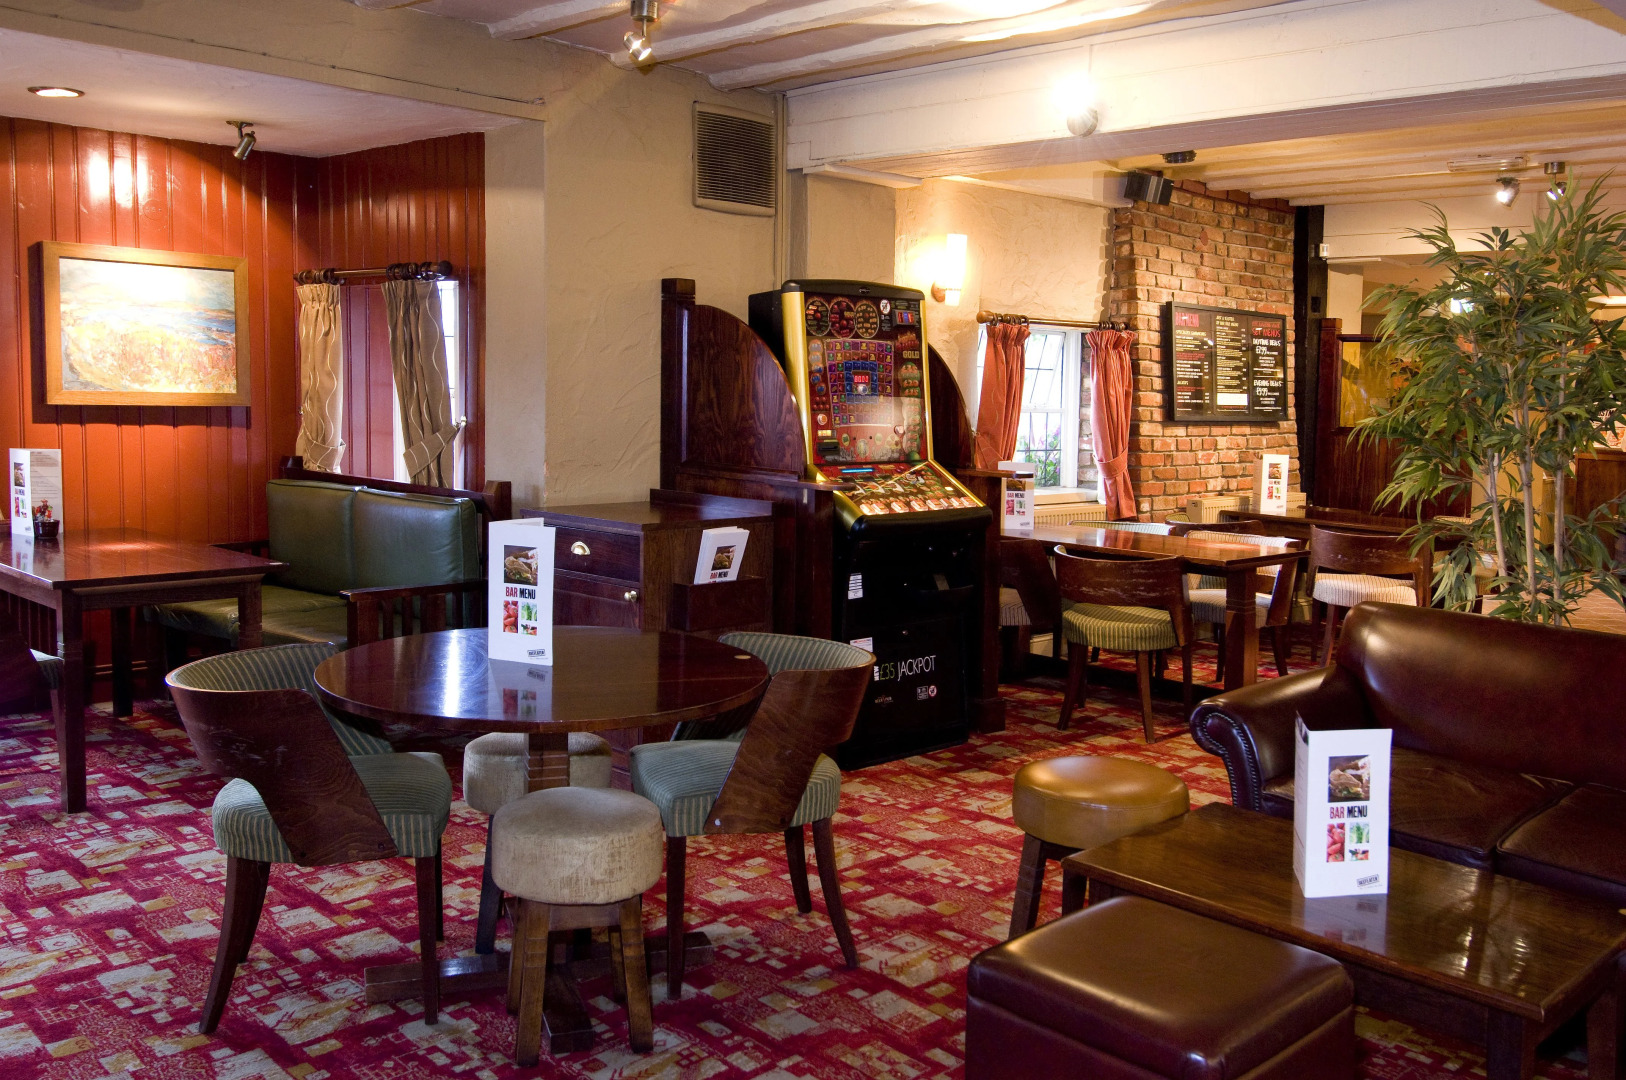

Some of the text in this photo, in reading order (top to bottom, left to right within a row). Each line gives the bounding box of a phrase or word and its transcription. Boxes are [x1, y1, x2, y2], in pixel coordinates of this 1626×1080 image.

[1263, 329, 1281, 338] MENUS
[1270, 339, 1281, 347] DEALS
[902, 350, 920, 358] GOLD
[1270, 380, 1282, 388] DEALS
[710, 570, 729, 579] BAR MENU
[505, 586, 536, 600] BAR MENU
[880, 662, 895, 680] £35
[897, 655, 937, 682] JACKPOT
[1329, 805, 1368, 819] BAR MENU
